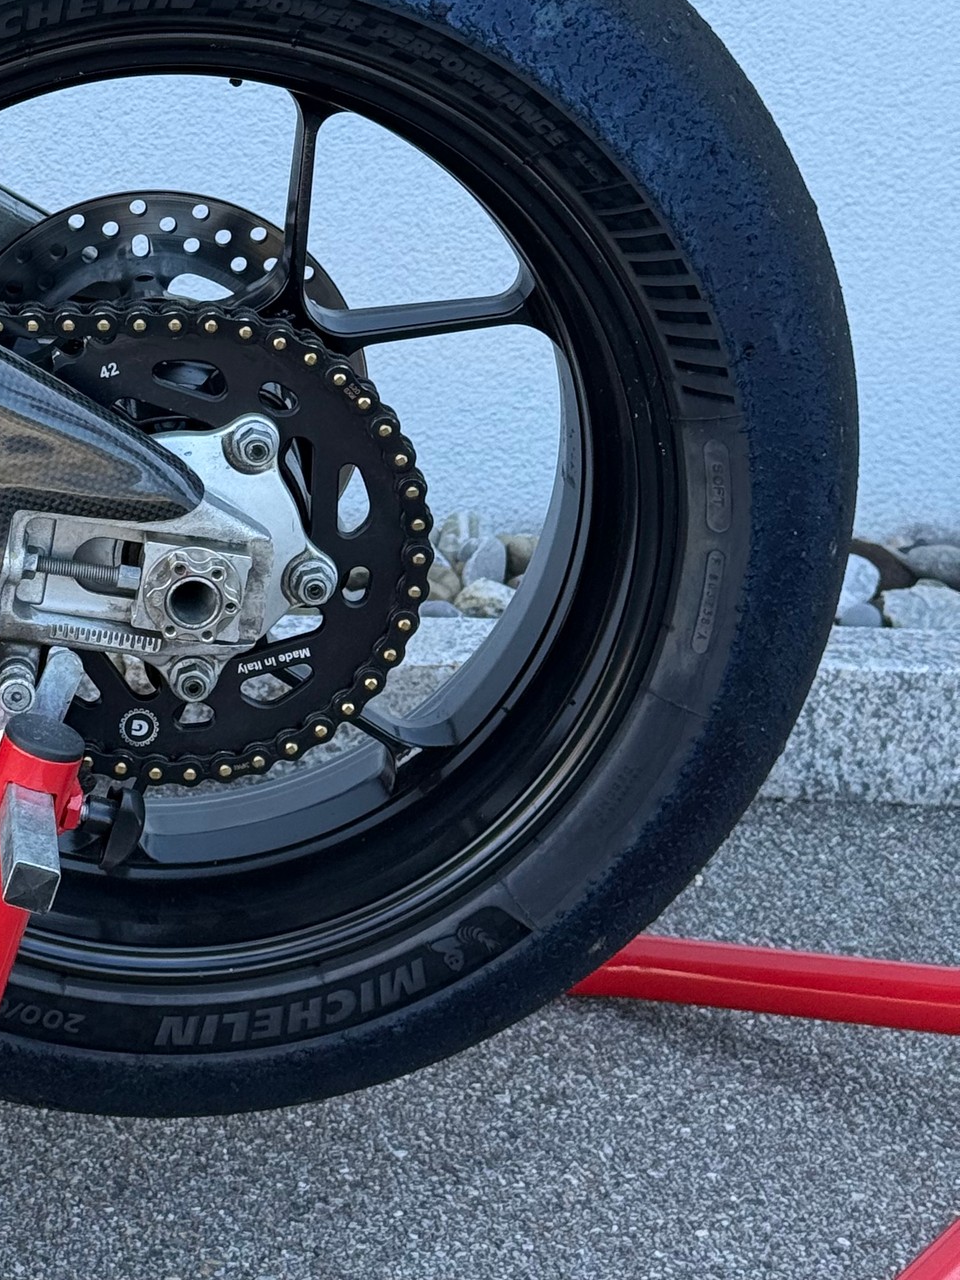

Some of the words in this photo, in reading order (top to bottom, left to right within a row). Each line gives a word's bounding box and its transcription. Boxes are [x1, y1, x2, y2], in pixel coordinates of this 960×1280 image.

[372, 24, 569, 146] PERFORMANCE
[100, 362, 120, 378] 42
[712, 464, 725, 507] SOFT
[278, 647, 311, 662] Made
[238, 660, 262, 674] Italy
[131, 719, 149, 736] G
[154, 957, 427, 1046] MICHELIN
